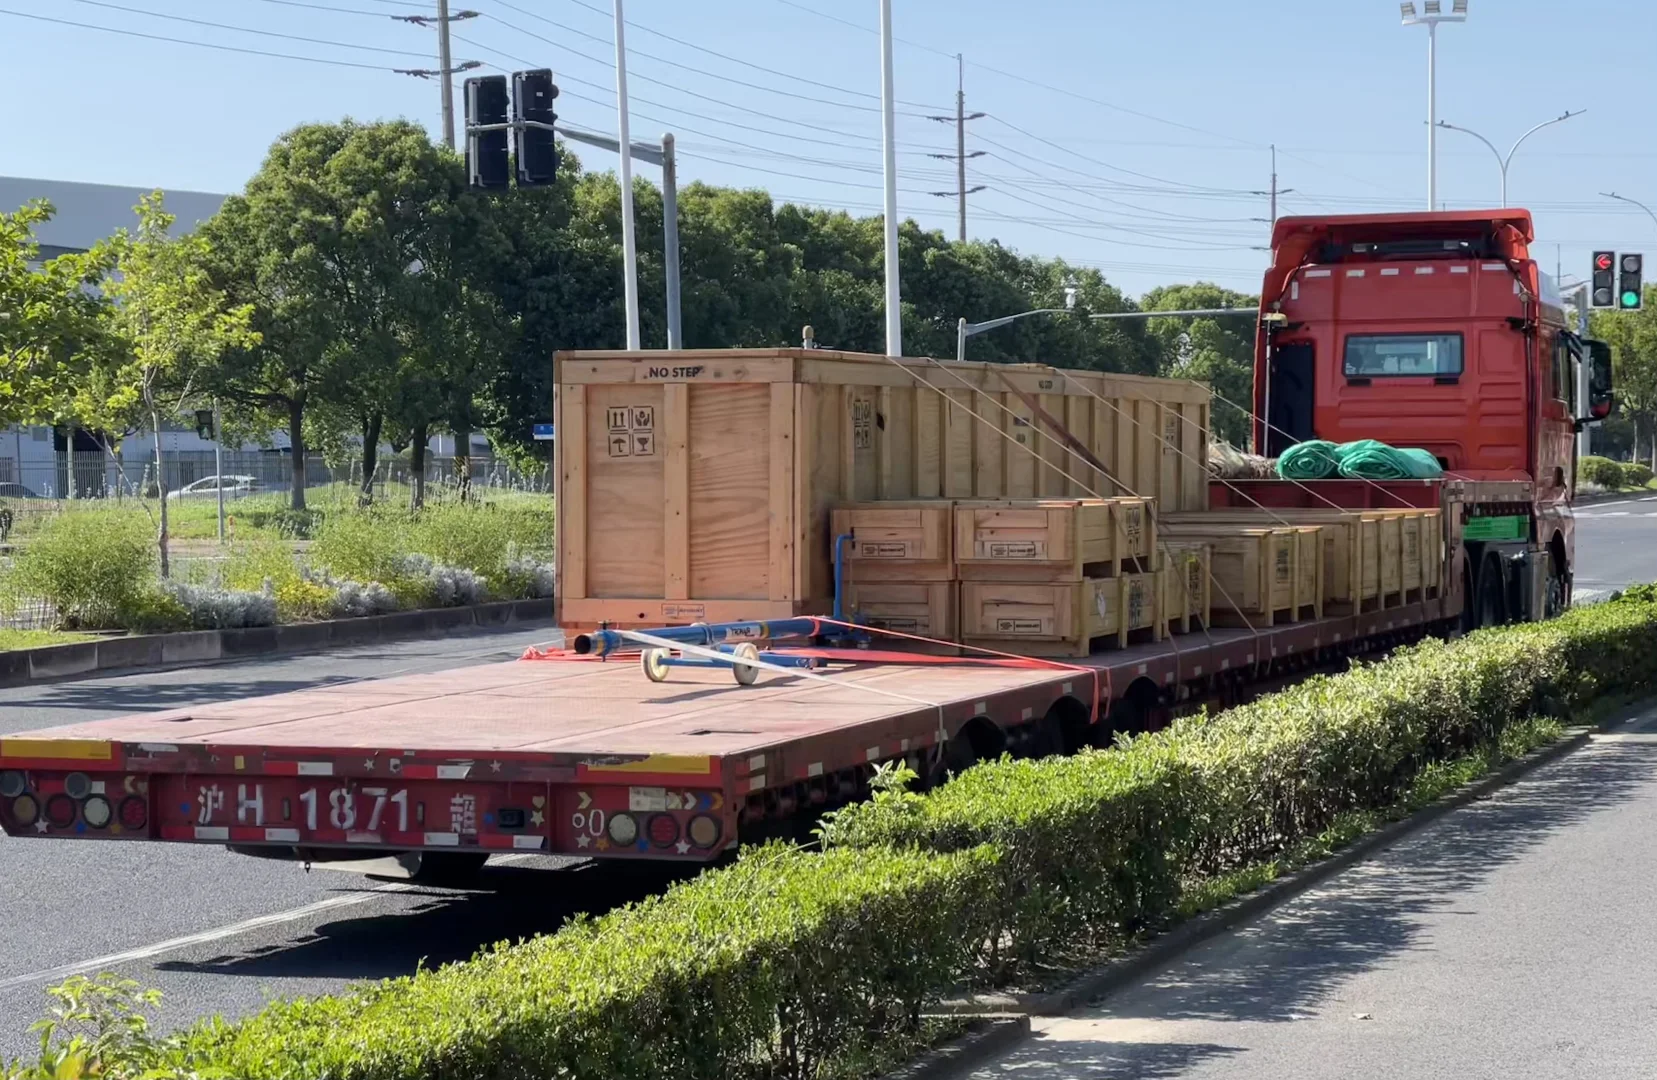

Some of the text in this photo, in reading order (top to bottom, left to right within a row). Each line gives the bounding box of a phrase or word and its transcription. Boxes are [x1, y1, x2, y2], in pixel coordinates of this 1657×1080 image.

[649, 366, 701, 378] NO STEP
[299, 787, 409, 832] 1871
